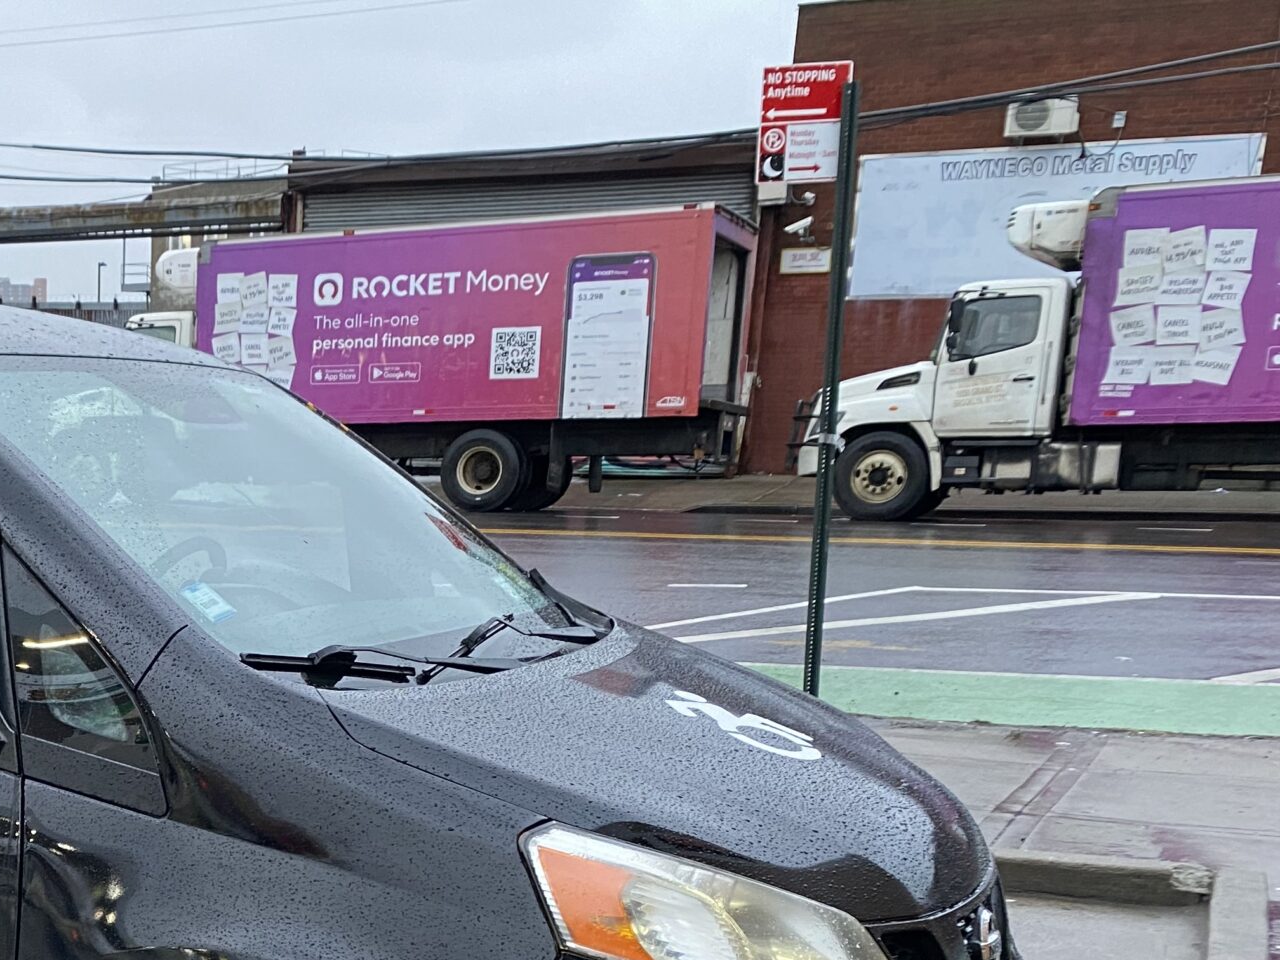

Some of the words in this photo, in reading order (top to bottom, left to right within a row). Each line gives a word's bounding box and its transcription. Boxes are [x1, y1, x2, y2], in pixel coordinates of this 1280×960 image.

[766, 72, 782, 84] NO
[785, 69, 836, 84] STOPPING
[767, 86, 810, 100] Anytime
[941, 156, 1048, 181] WAYNECO
[1051, 153, 1115, 176] Metal
[1119, 149, 1197, 175] Supply
[352, 271, 461, 299] ROCKET
[466, 270, 549, 296] Money
[313, 315, 341, 330] The
[344, 313, 419, 329] all-in-one
[1163, 319, 1190, 328] CANCEL
[312, 335, 378, 353] personal
[382, 333, 439, 348] finance
[443, 332, 475, 349] app
[324, 373, 338, 382] App
[339, 372, 356, 380] Store
[383, 370, 404, 380] Google
[405, 370, 417, 379] Play
